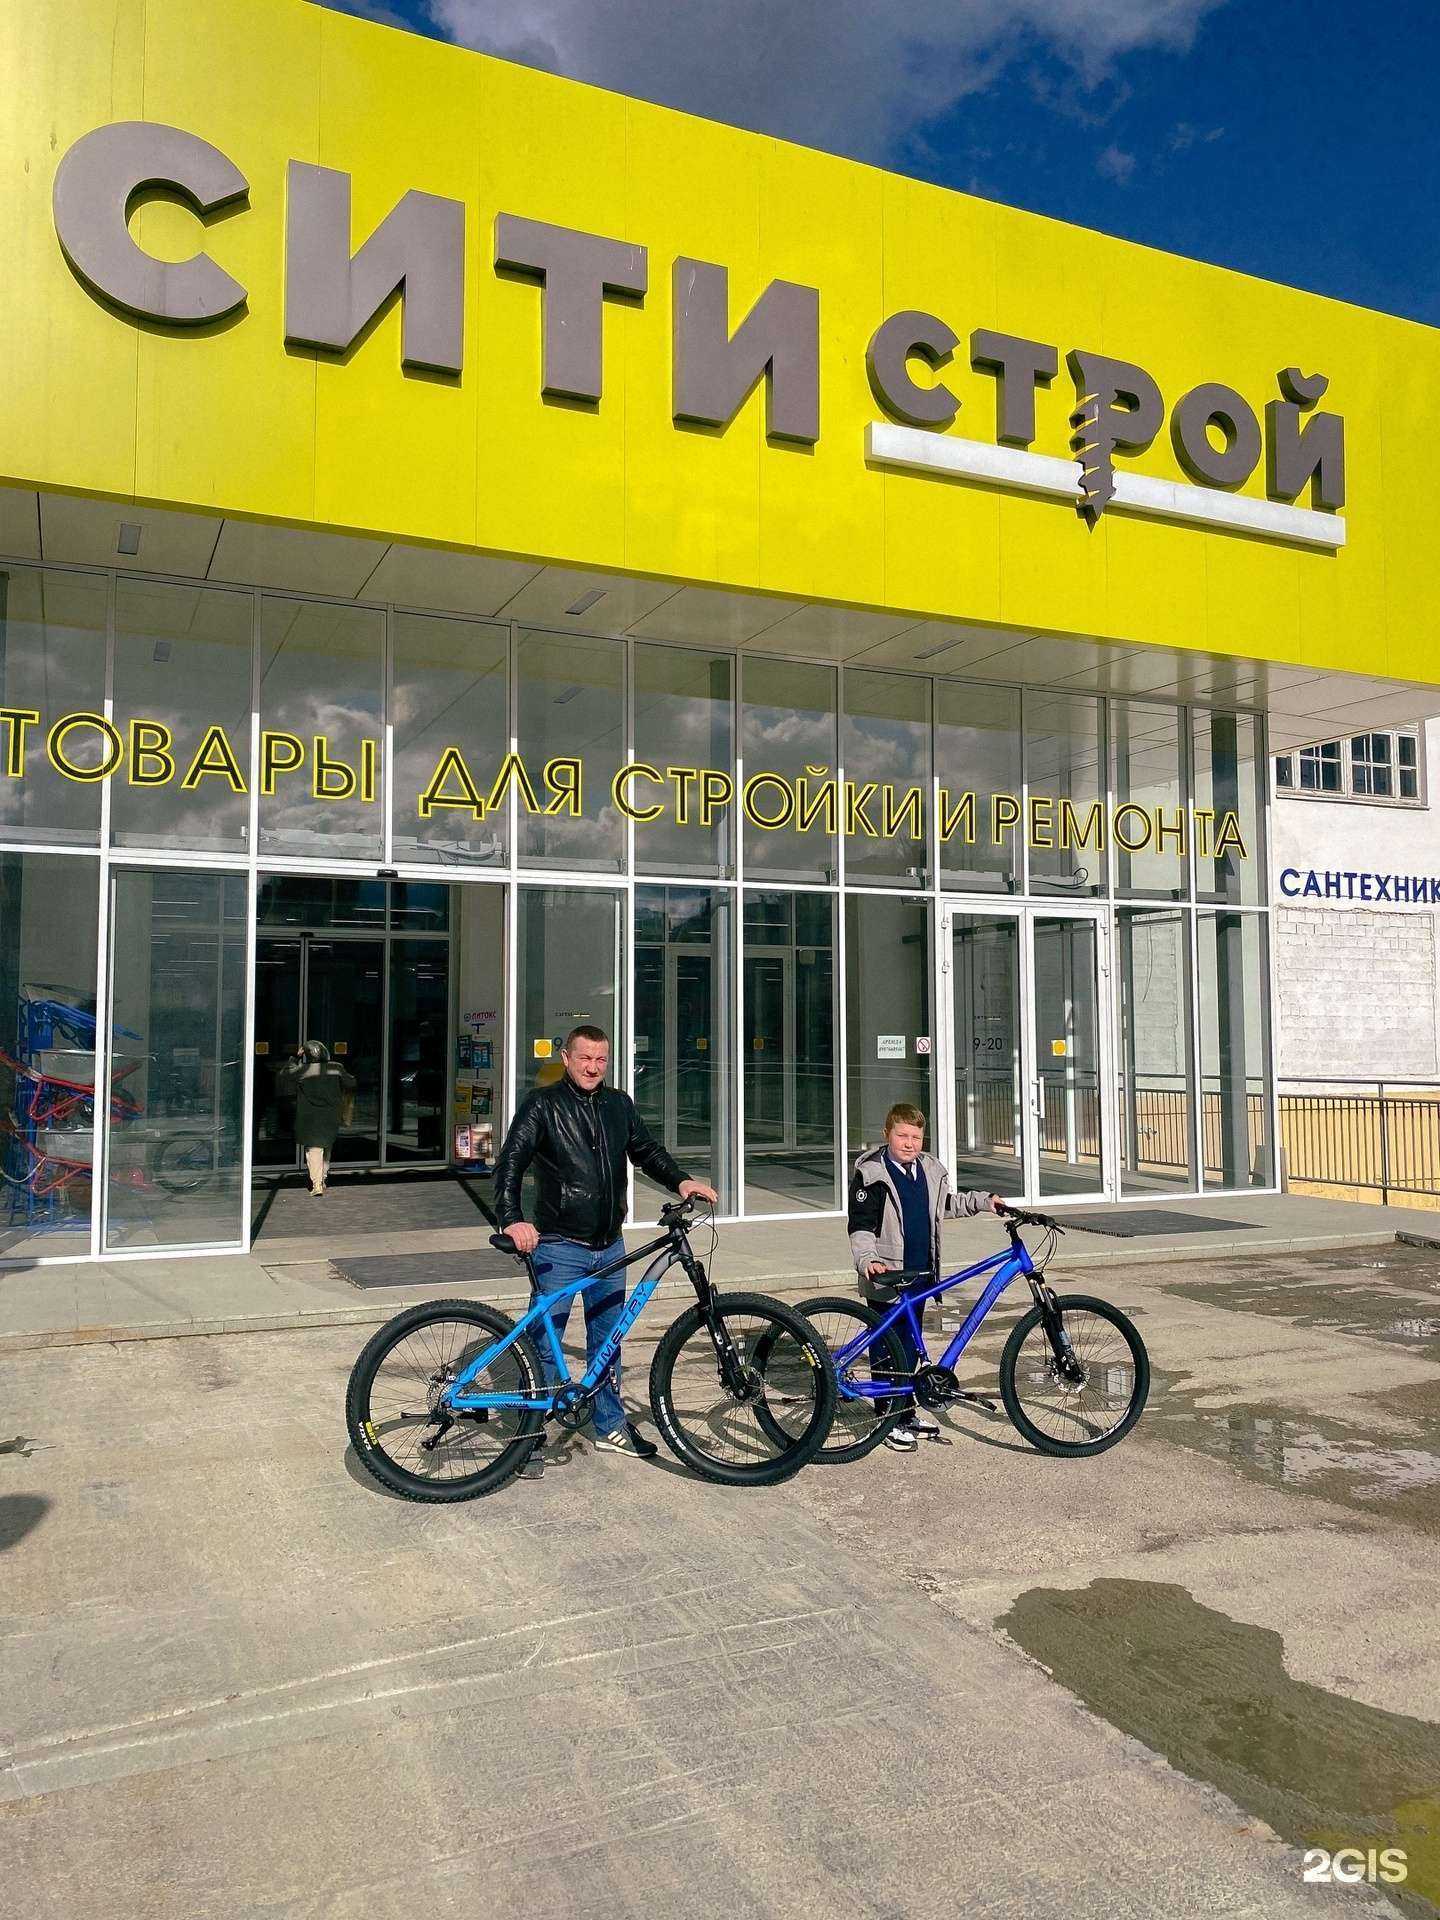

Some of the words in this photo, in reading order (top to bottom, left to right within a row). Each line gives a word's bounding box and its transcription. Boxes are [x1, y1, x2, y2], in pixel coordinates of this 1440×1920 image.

[52, 120, 820, 447] СИТИ
[866, 310, 1346, 533] СТРОЙ
[0, 707, 376, 802] ТОВАРЫ
[418, 746, 583, 820] ДЛЯ
[611, 762, 923, 841] СТРОЙКИ
[938, 789, 976, 844] И
[990, 793, 1250, 860] РЕМОНТА
[1280, 868, 1440, 904] САНТЕХНИК
[972, 1037, 1003, 1050] 9-20
